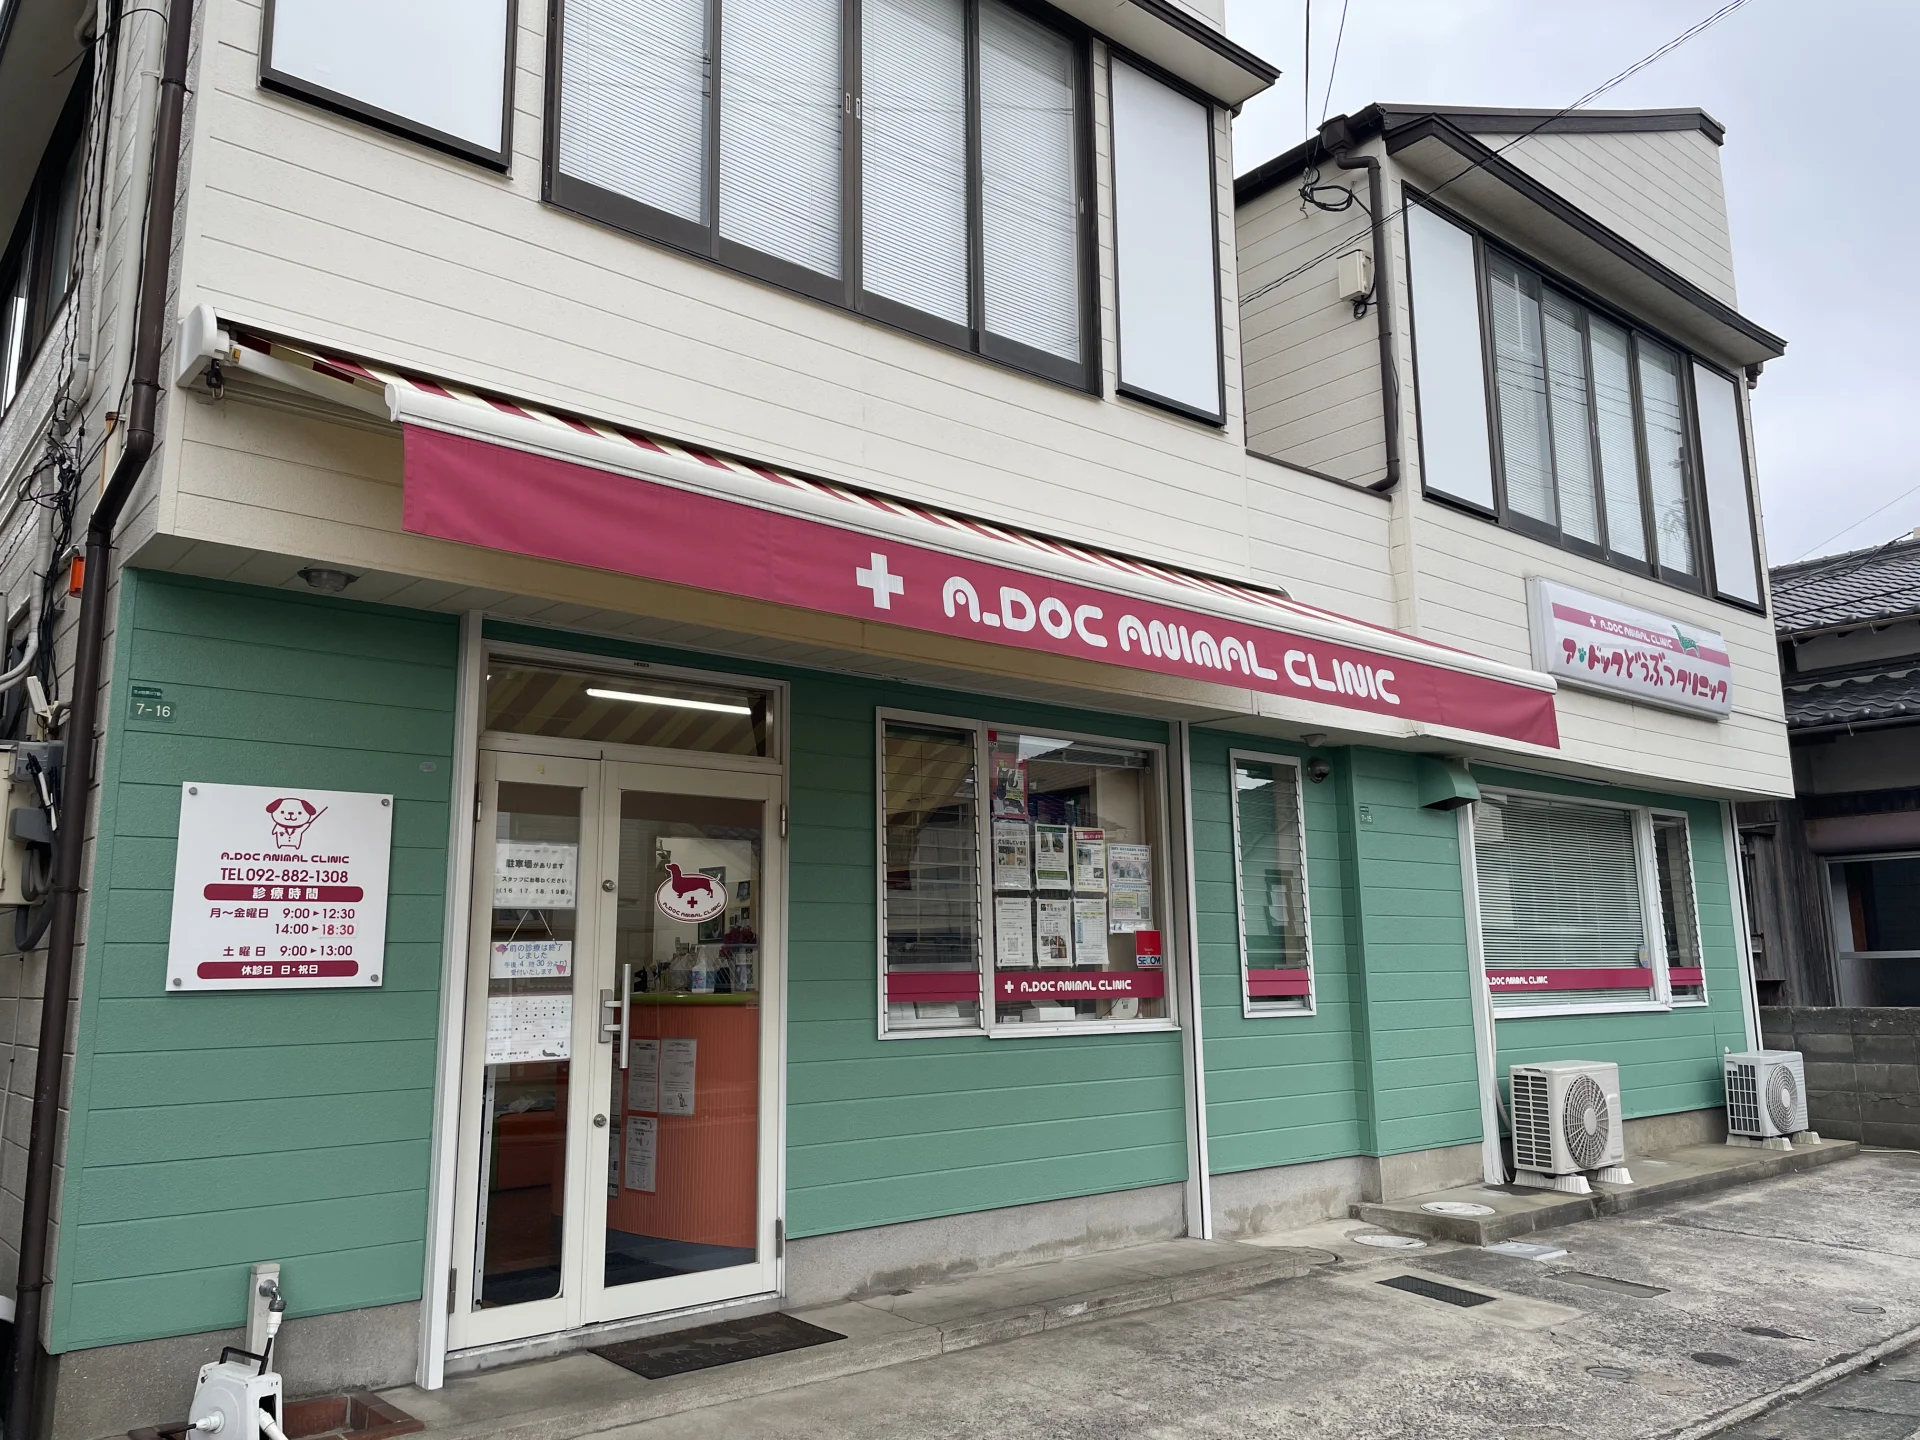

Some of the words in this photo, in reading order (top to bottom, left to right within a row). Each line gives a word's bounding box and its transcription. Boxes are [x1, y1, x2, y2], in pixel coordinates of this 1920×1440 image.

[1624, 626, 1651, 643] ANIMAL
[1650, 634, 1673, 649] CLINIC
[1118, 614, 1278, 681] ANIMAL
[1284, 649, 1401, 705] CLINIC
[136, 702, 171, 718] 7-16
[263, 853, 308, 863] ANIMAL
[311, 855, 350, 864] CLINIC
[506, 859, 565, 869] 駐車場があります
[252, 887, 319, 900] 診療時間
[282, 908, 310, 919] 9:00
[322, 908, 355, 919] 12:30
[703, 902, 721, 916] CLINIC
[275, 923, 309, 935] 14:00
[322, 924, 355, 936] 18:30
[223, 946, 266, 956] 土曜日
[280, 946, 307, 956] 9:00
[320, 945, 353, 956] 13:00
[518, 952, 548, 960] しました
[1138, 956, 1161, 965] SECOM
[241, 965, 273, 976] 休診日
[281, 964, 318, 975] 日・祝日
[511, 968, 553, 977] 受付いたします
[1057, 980, 1097, 991] ANIMAL
[1098, 979, 1132, 991] CLINIC
[1505, 976, 1528, 985] ANIMAL
[1528, 975, 1548, 985] CLINIC
